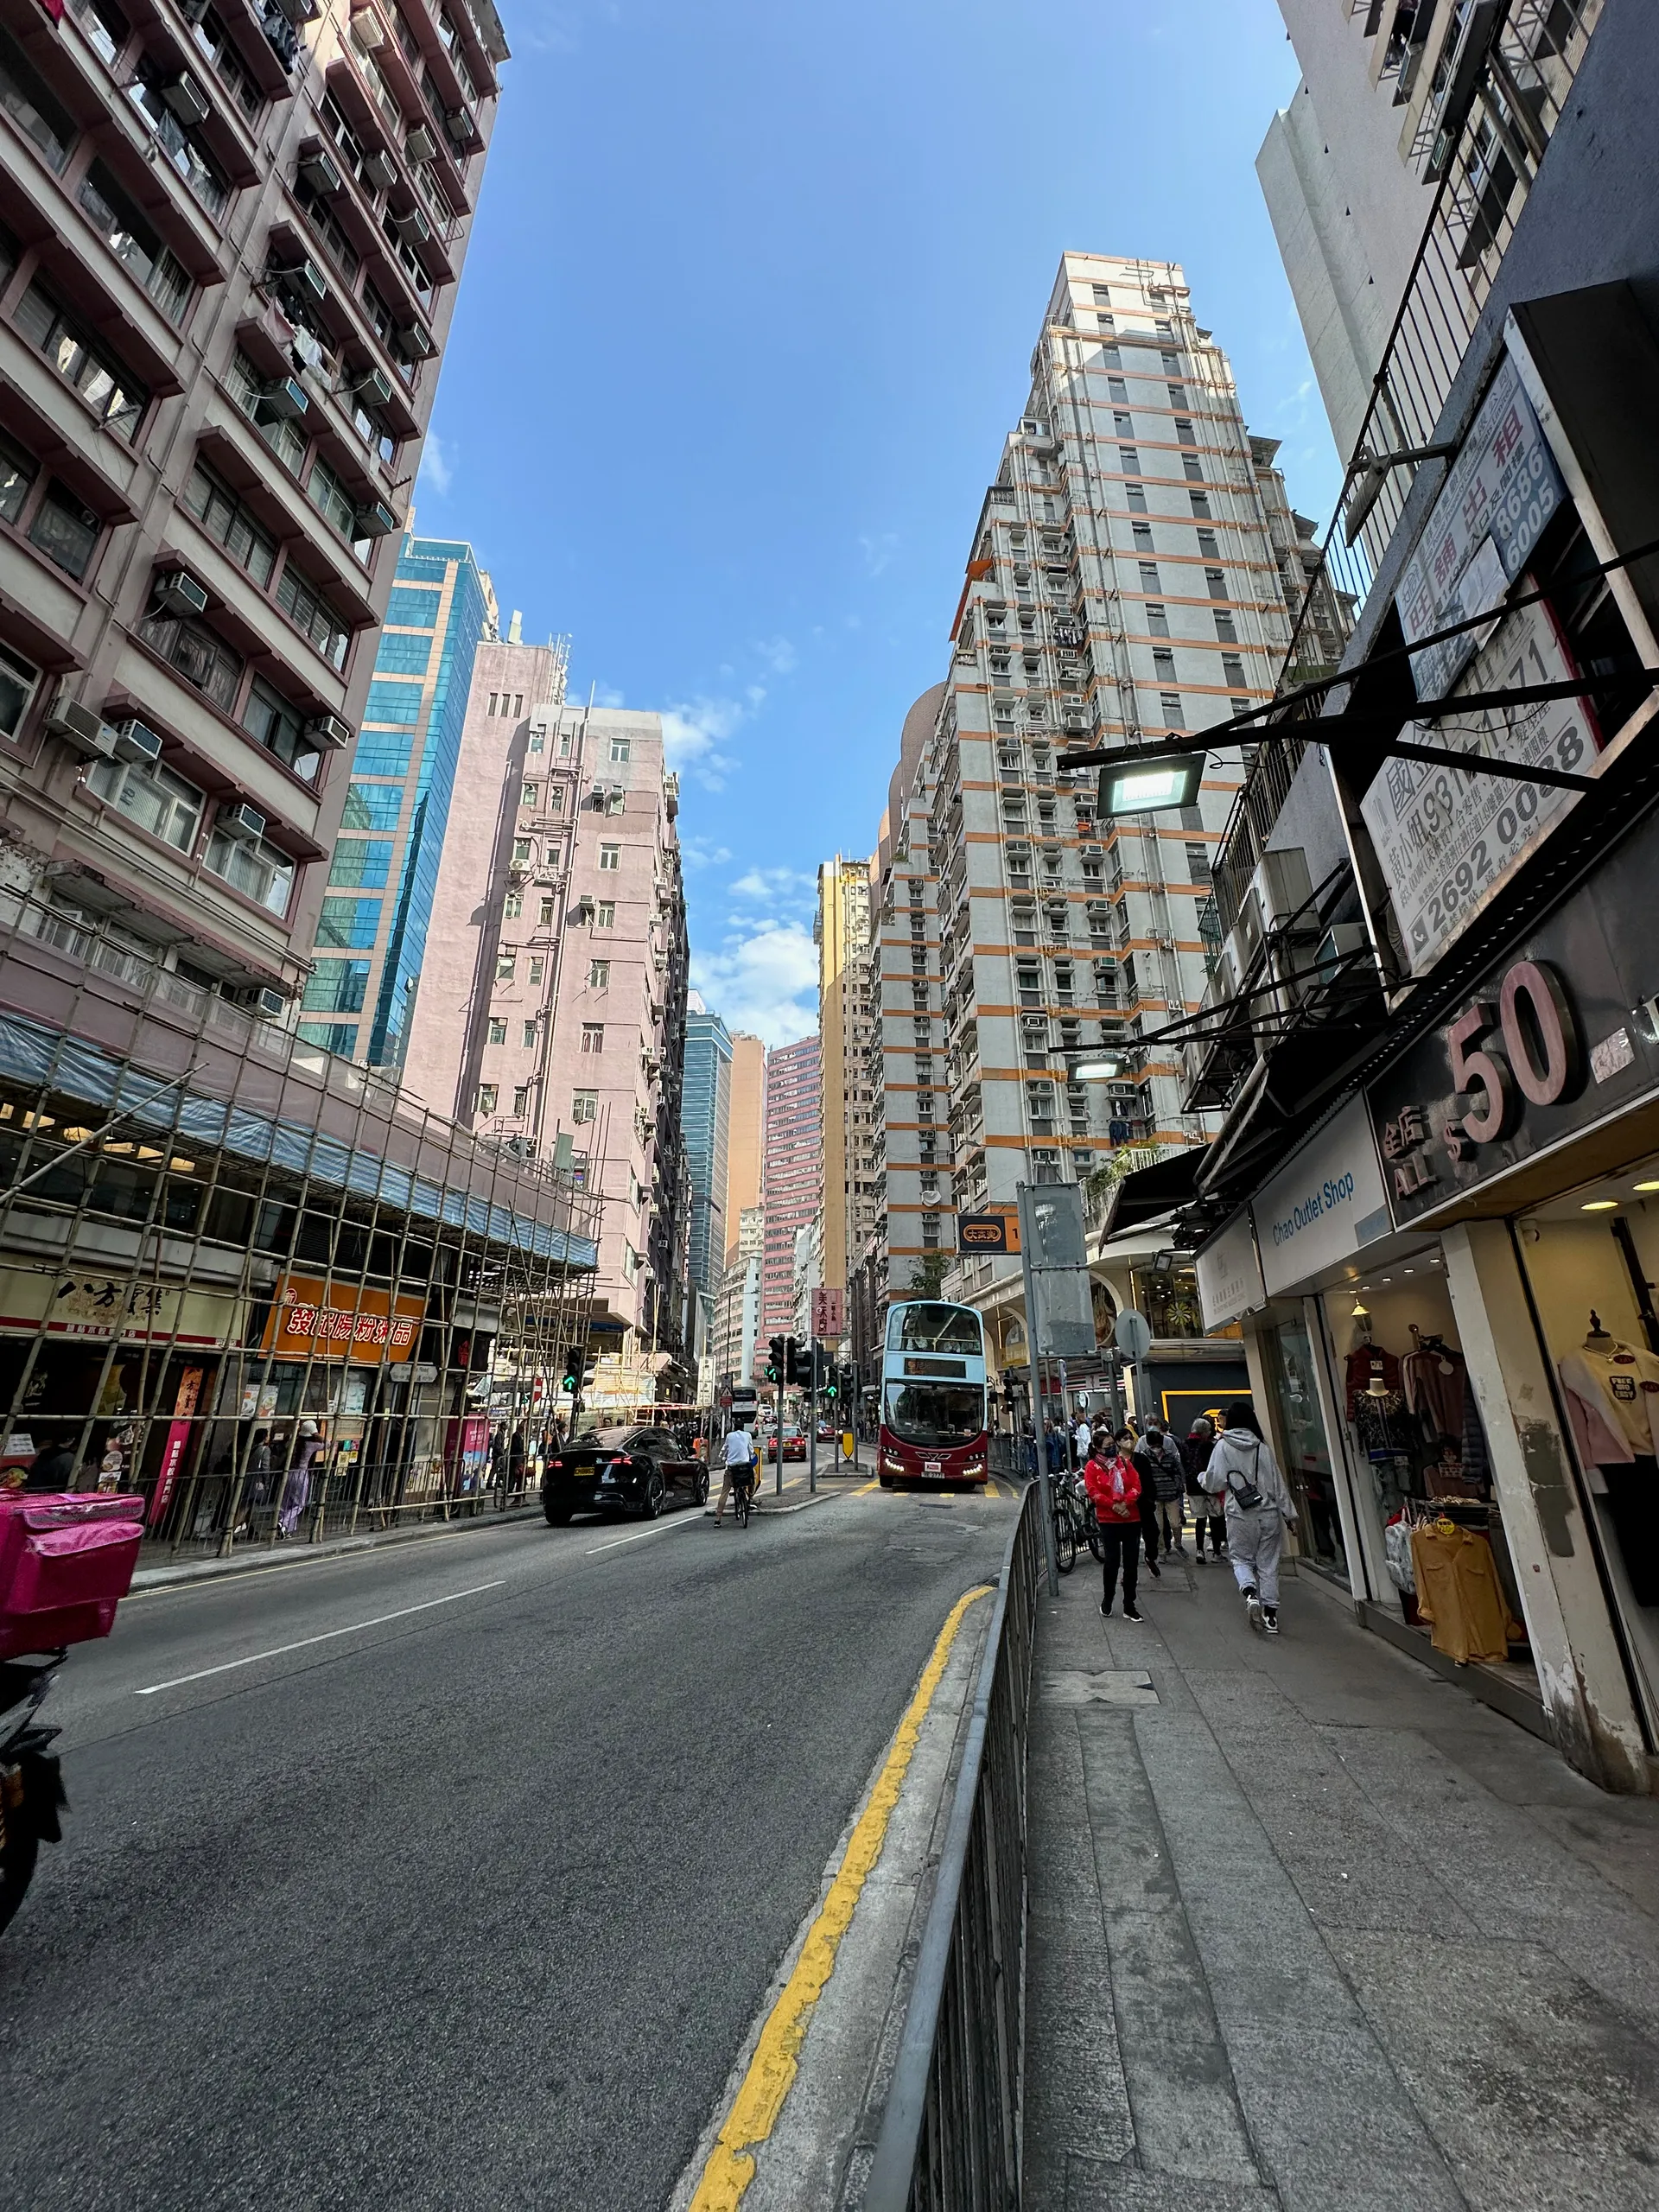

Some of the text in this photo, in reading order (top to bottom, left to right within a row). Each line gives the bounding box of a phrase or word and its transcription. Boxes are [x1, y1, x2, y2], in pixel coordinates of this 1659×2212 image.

[1496, 445, 1543, 542] 8686
[1506, 476, 1554, 572] 6005
[1388, 808, 1431, 890] 黃小姐
[1427, 724, 1586, 932] 2692 0088
[1273, 1219, 1294, 1246] Chao
[1294, 1192, 1325, 1230] Outlet
[1323, 1172, 1354, 1209] Shop
[1395, 1156, 1438, 1201] ALL
